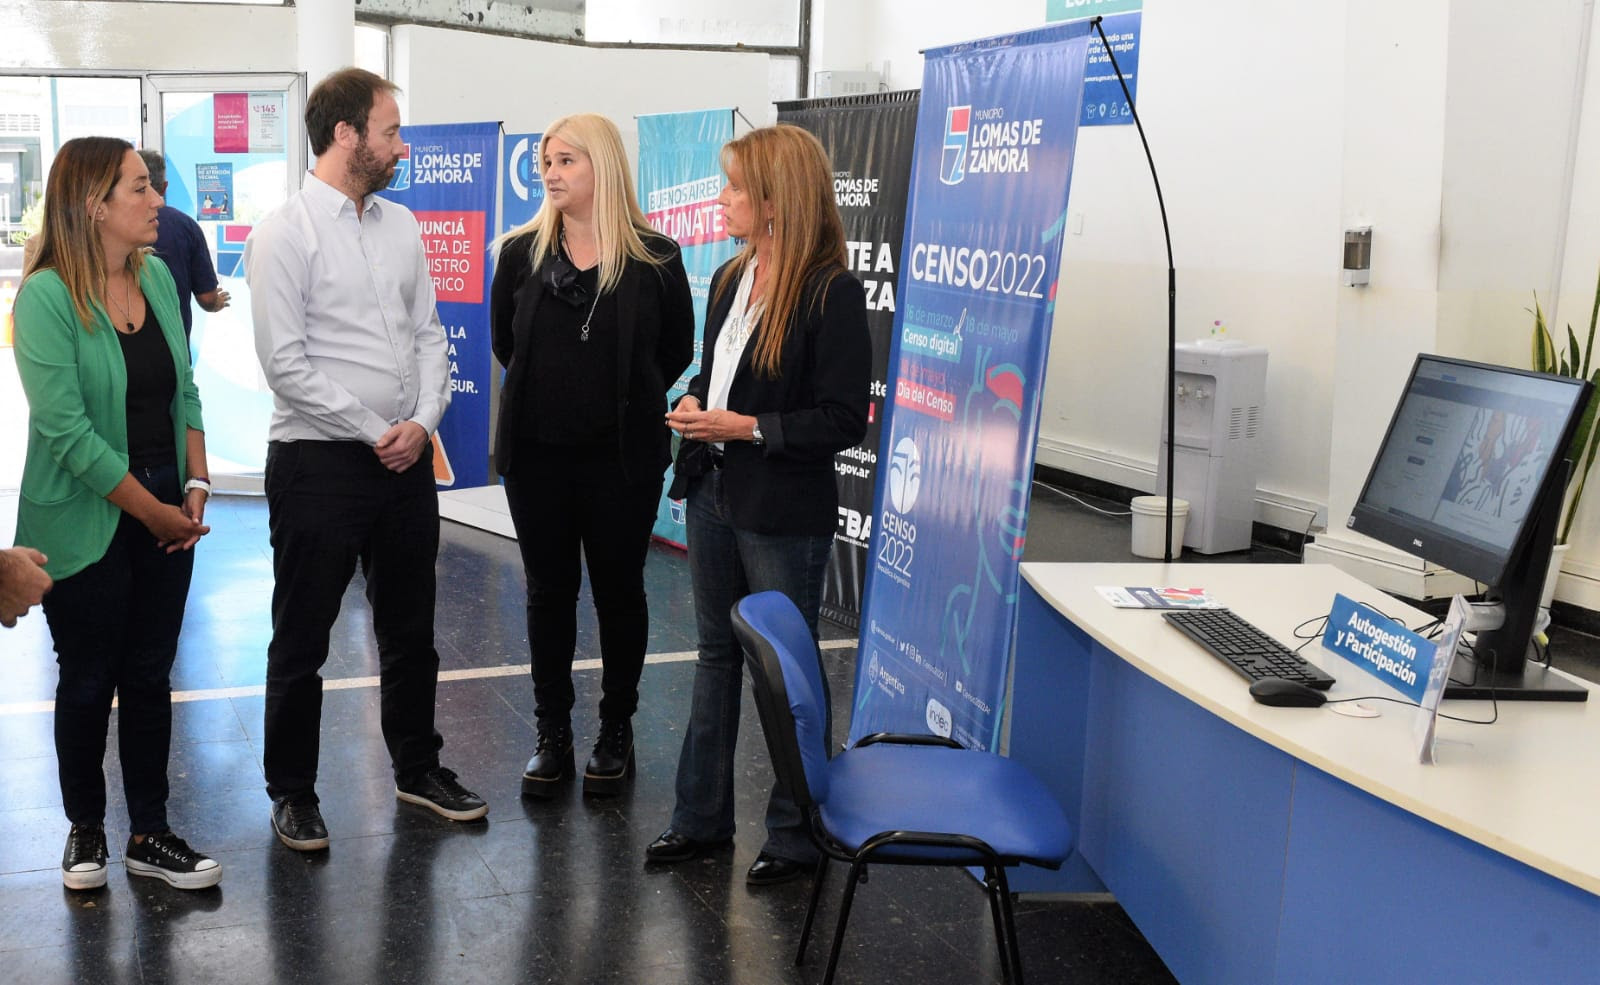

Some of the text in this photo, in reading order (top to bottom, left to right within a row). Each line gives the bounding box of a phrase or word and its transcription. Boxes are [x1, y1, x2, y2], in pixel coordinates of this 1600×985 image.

[1089, 53, 1112, 64] de vid
[261, 105, 276, 113] 145
[972, 119, 1042, 148] LOMAS DE
[414, 153, 482, 169] LOMAS DE
[968, 147, 1029, 173] ZAMORA
[414, 168, 473, 184] ZAMORA
[833, 179, 879, 192] OMAS DE
[650, 179, 719, 210] BUENOS AIRES
[835, 192, 871, 207] AMORA
[452, 239, 471, 255] DE
[874, 242, 895, 273] A
[430, 276, 465, 292] RICO
[450, 325, 467, 339] LA
[906, 303, 914, 321] 16
[915, 307, 926, 323] de
[927, 312, 955, 328] marzo
[991, 325, 1019, 345] mayo
[903, 327, 960, 356] Censo digital
[911, 386, 925, 406] del
[926, 391, 953, 413] Censo
[882, 510, 917, 544] CENSO
[878, 531, 914, 578] 2022
[1348, 611, 1417, 661] Autogestión
[1334, 629, 1417, 687] y Participación
[880, 665, 905, 695] Argentina
[929, 705, 949, 732] indec
